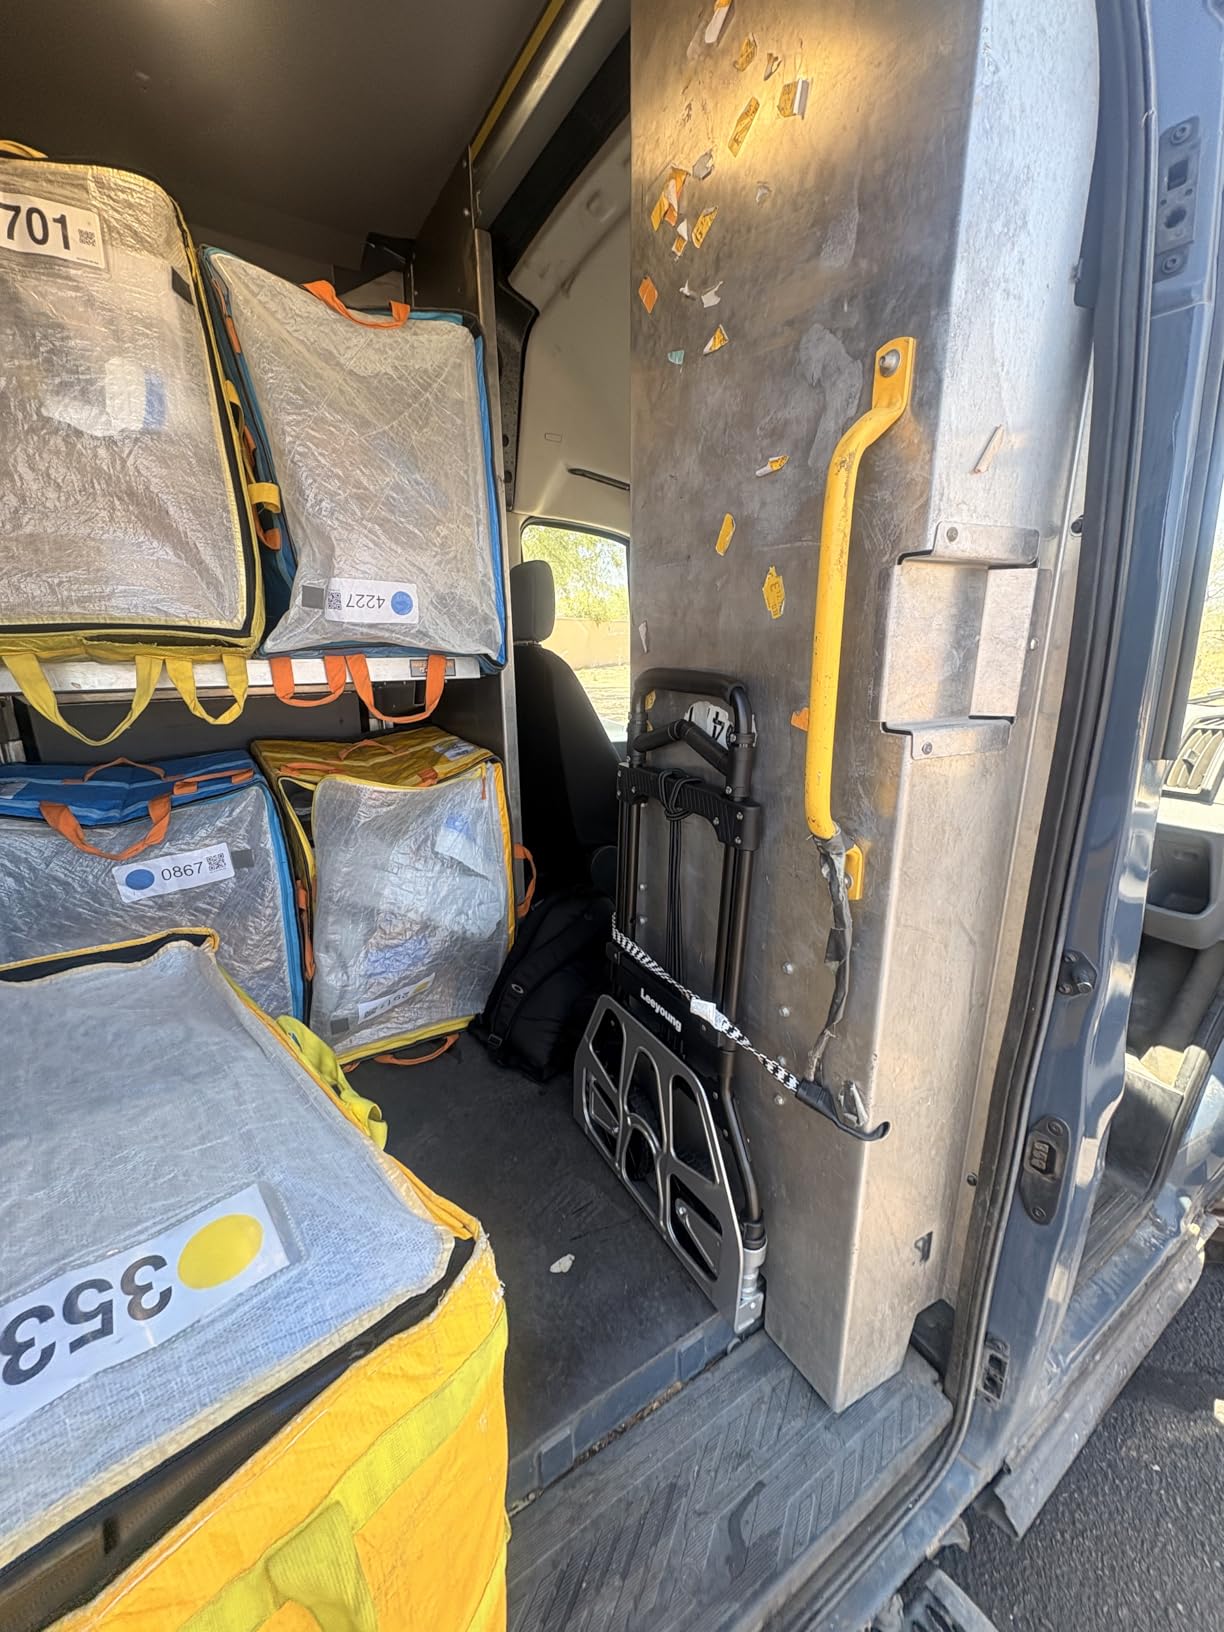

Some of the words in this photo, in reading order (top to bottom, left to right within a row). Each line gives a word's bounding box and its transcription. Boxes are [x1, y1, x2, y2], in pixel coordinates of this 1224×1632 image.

[0, 202, 71, 251] 701
[346, 594, 386, 609] 4227
[161, 861, 203, 881] 0867
[640, 987, 682, 1033] Leeyoung
[0, 1254, 173, 1386] 353
